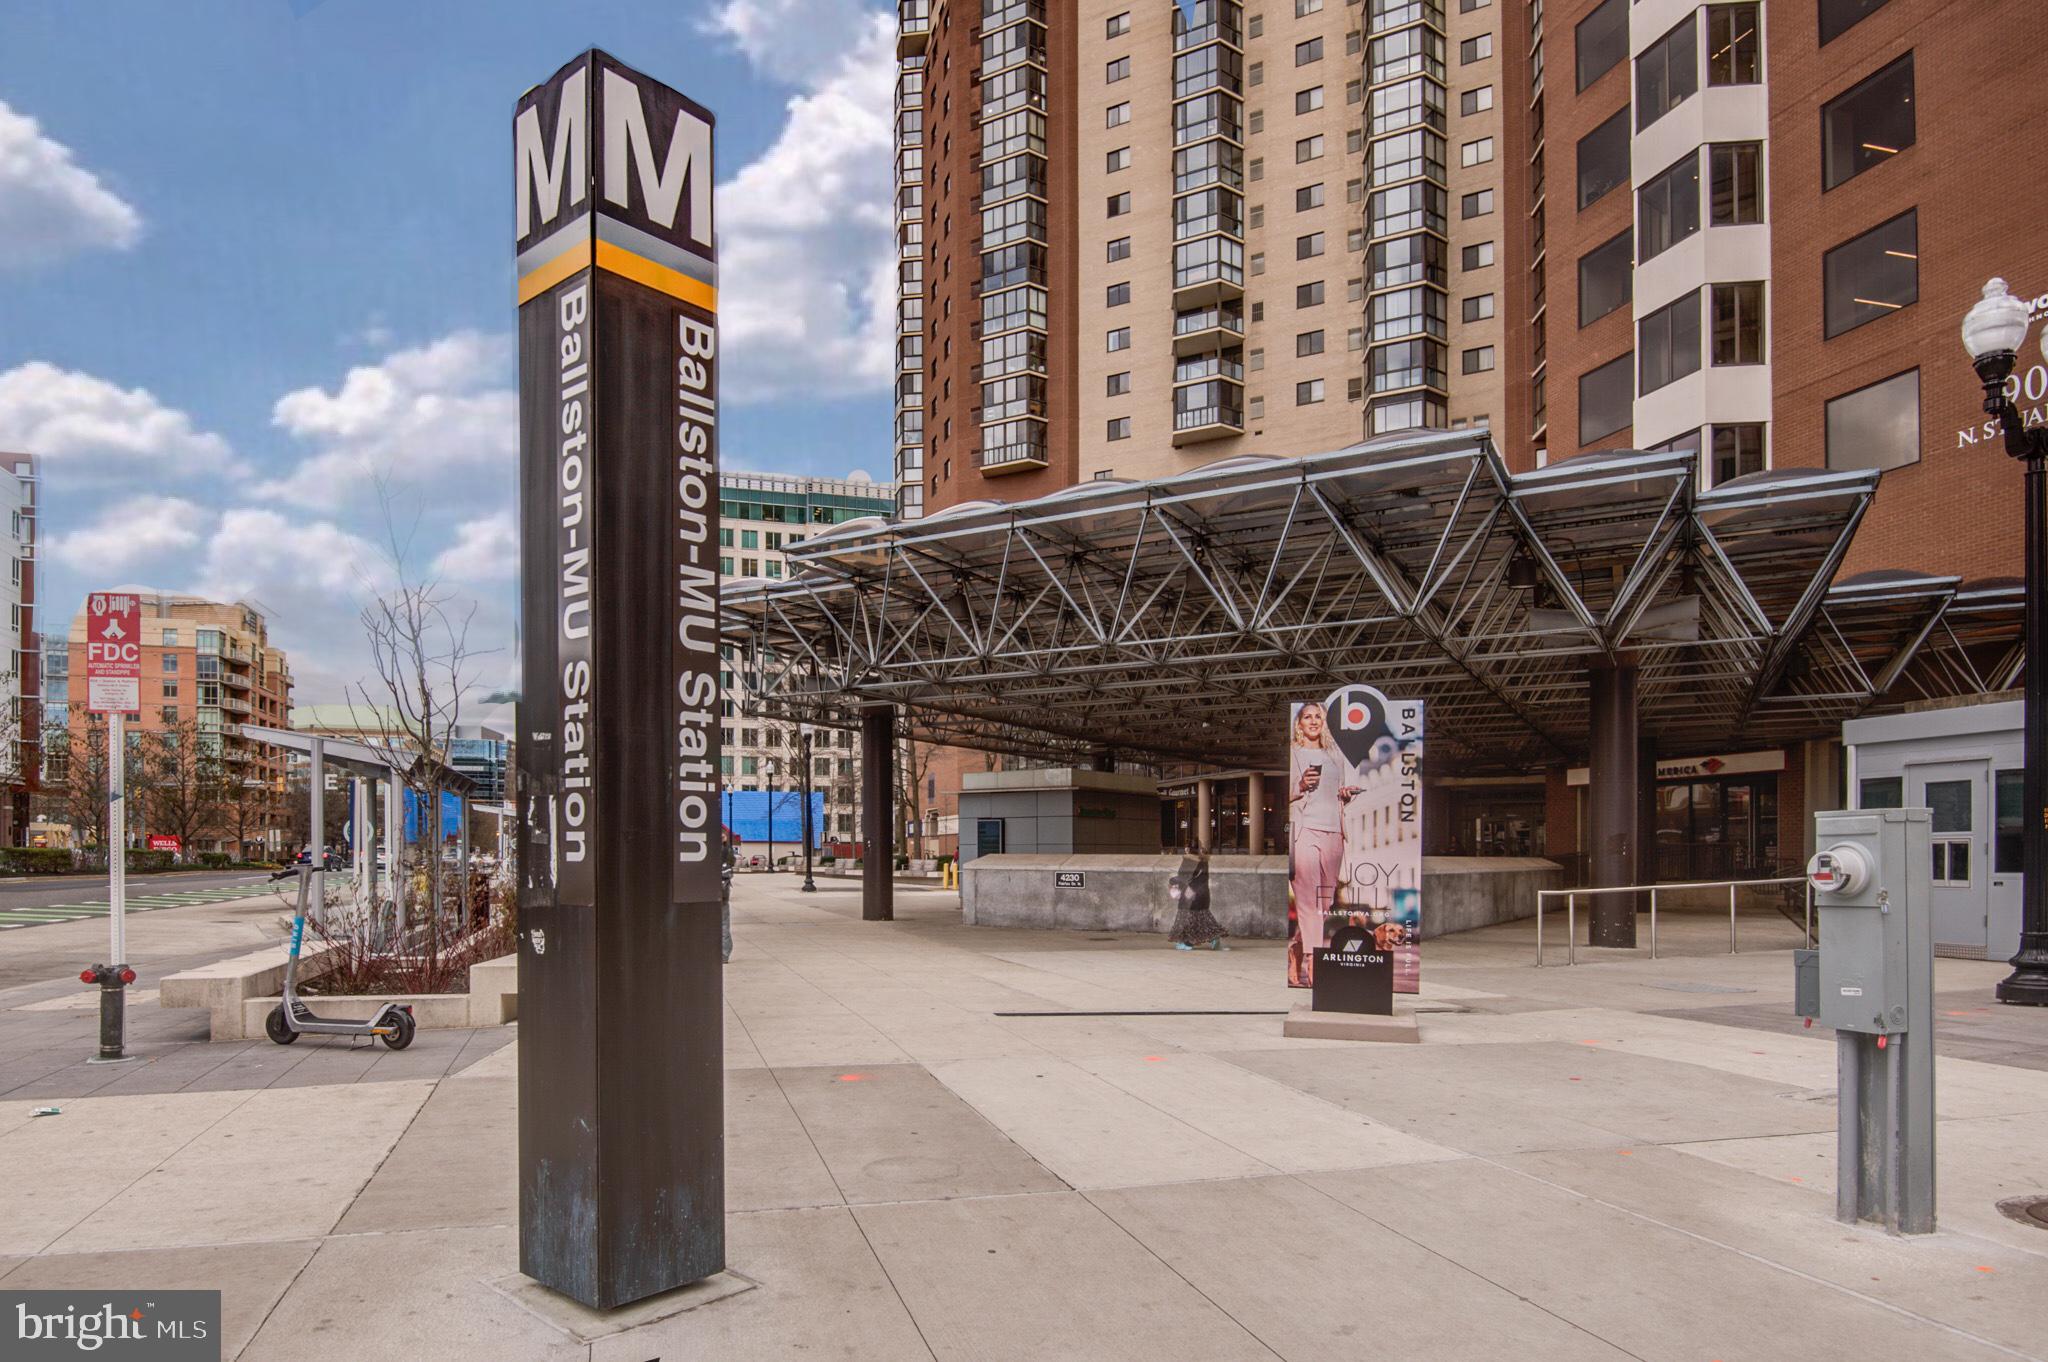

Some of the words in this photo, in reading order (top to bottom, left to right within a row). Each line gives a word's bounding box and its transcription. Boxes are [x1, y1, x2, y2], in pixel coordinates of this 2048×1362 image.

[516, 66, 586, 241] M
[603, 67, 712, 248] M
[560, 284, 591, 640] Ballston-MU
[679, 315, 715, 654] Ballston-MU
[88, 642, 139, 662] FDC
[563, 660, 591, 863] Station
[679, 670, 716, 863] Station
[1401, 708, 1415, 823] BALLSTON
[1322, 953, 1384, 964] ARLINGTON
[1341, 862, 1399, 886] JOY
